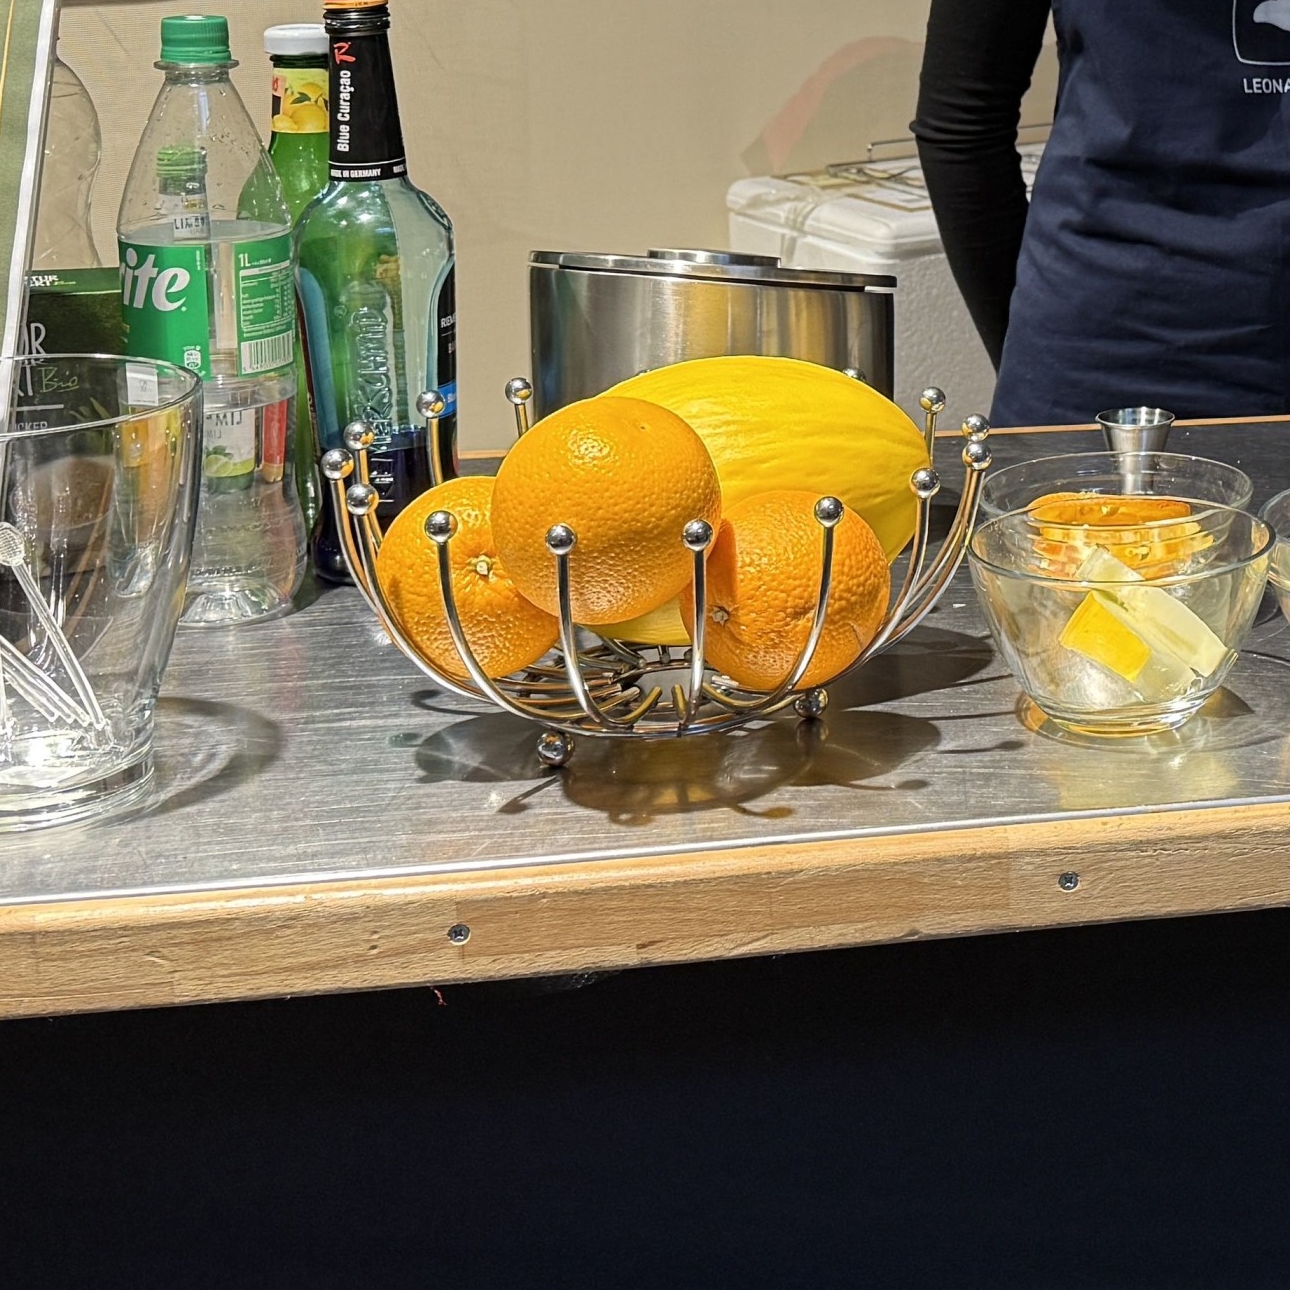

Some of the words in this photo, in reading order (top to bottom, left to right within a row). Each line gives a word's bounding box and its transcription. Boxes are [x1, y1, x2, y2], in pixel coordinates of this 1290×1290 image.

[337, 70, 355, 122] Curaçao
[337, 130, 350, 152] Blue
[350, 168, 382, 178] GERMANY
[238, 253, 251, 268] 1L
[37, 366, 80, 393] Bio
